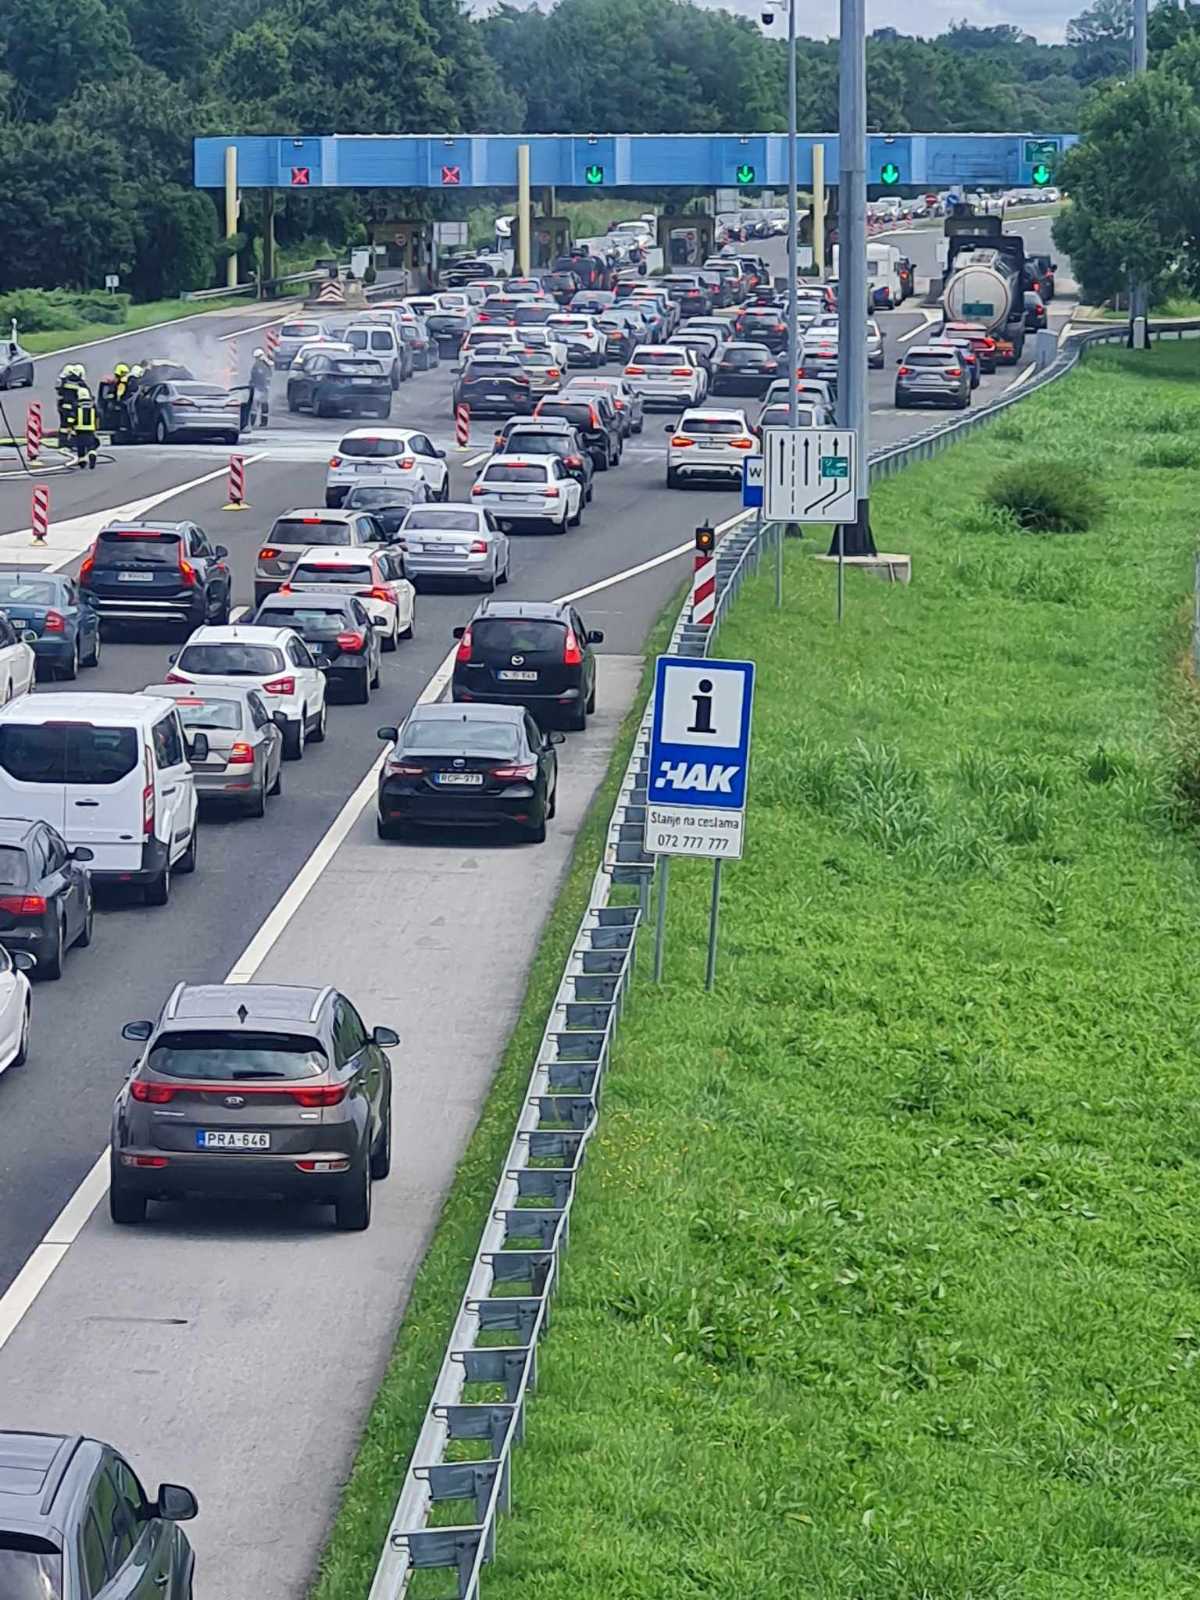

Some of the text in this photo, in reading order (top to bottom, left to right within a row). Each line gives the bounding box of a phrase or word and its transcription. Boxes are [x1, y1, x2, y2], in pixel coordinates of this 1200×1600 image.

[655, 761, 740, 793] HAK
[651, 811, 681, 828] Stanje
[684, 817, 695, 827] na
[657, 834, 729, 850] 072 777 777
[207, 1133, 266, 1146] PRA-646
